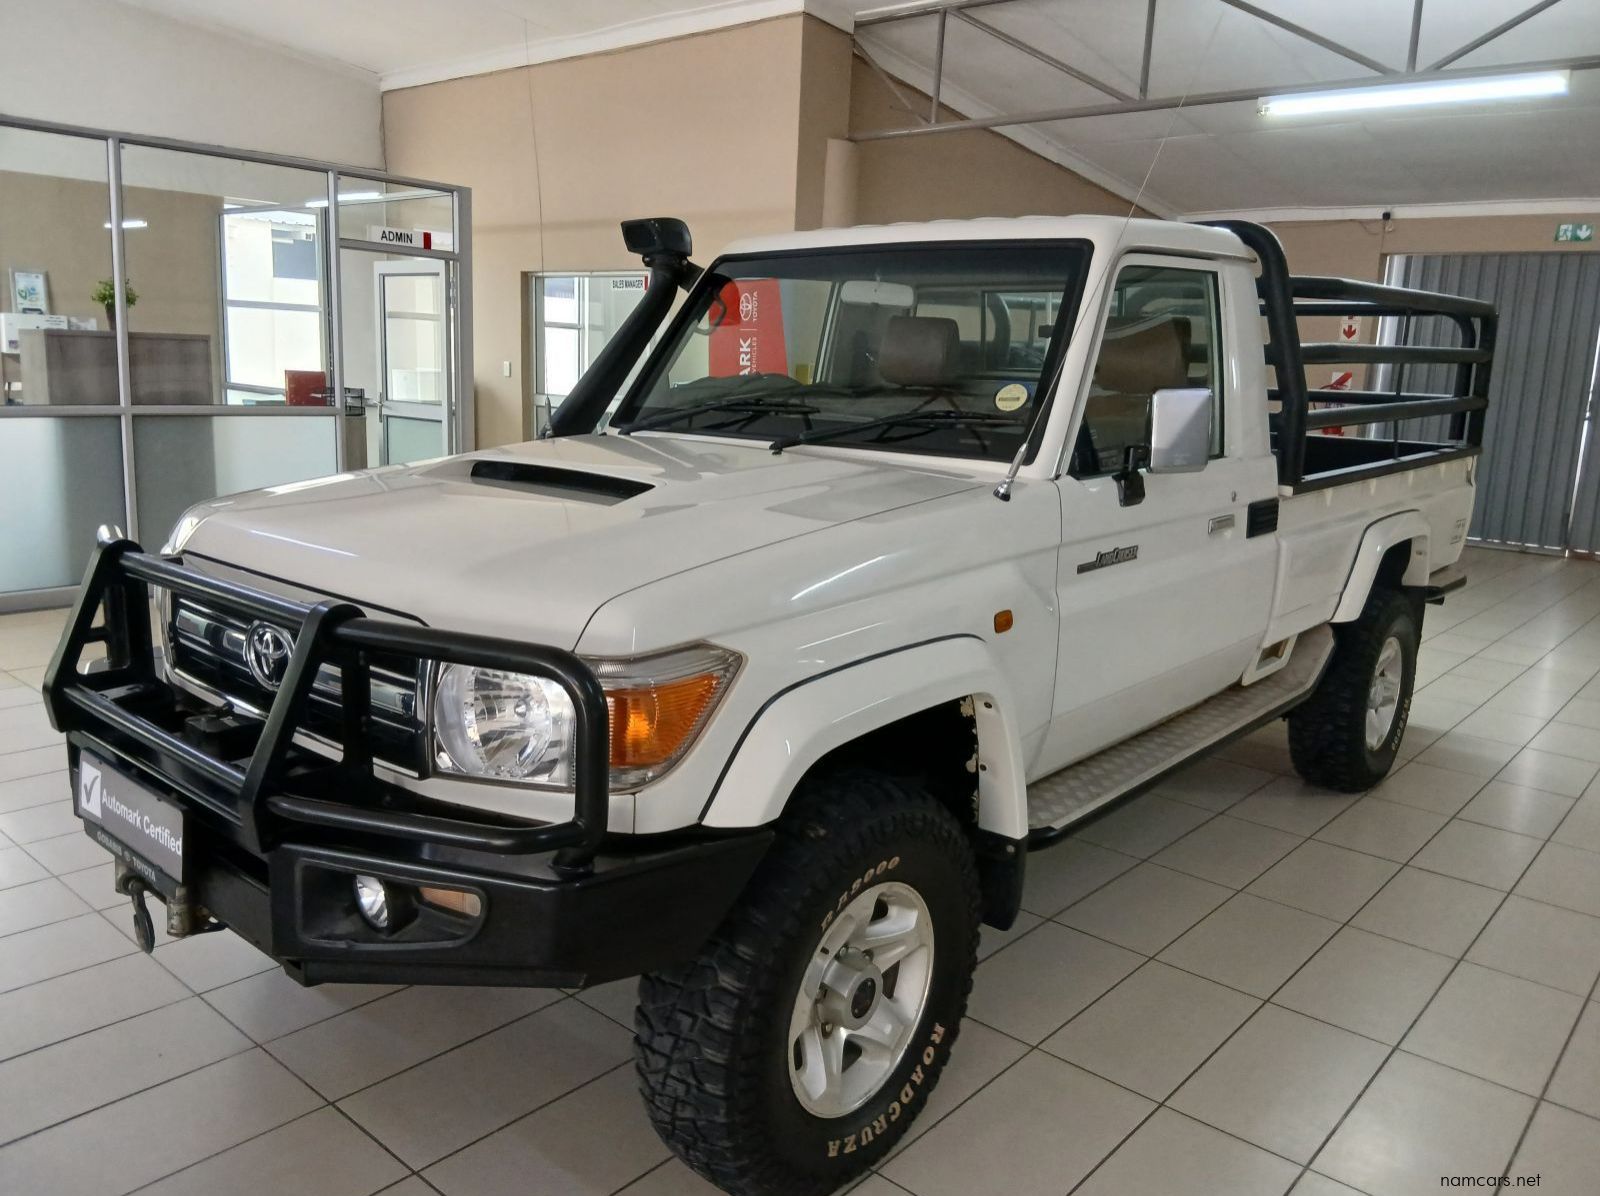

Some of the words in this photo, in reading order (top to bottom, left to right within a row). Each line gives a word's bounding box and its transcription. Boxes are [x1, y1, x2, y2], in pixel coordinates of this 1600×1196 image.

[381, 230, 413, 244] ADMIN
[624, 279, 643, 289] MANAGER
[101, 788, 142, 830] Automark
[143, 815, 183, 857] Certified
[827, 1022, 947, 1158] ROADCRUZA
